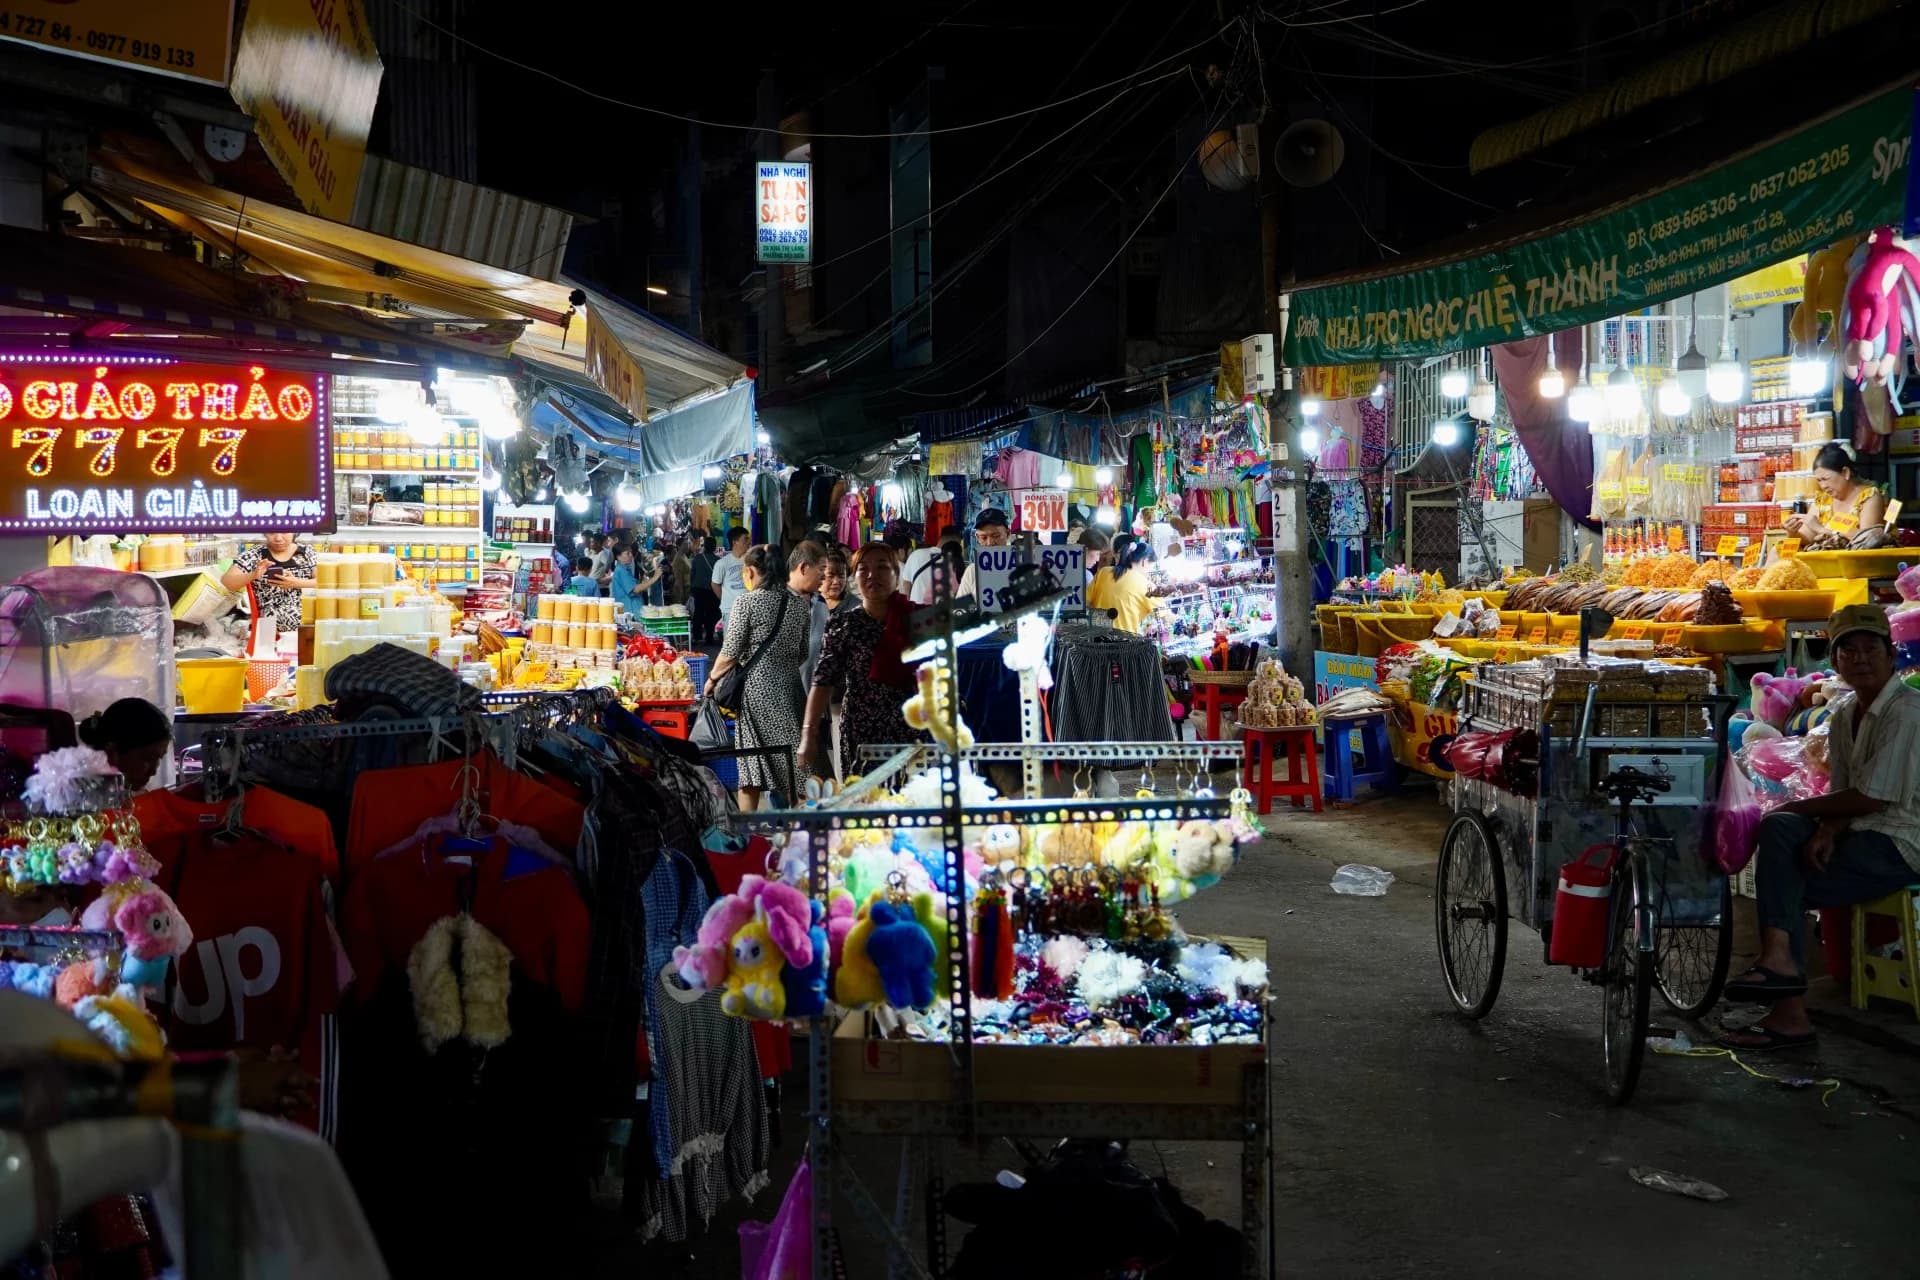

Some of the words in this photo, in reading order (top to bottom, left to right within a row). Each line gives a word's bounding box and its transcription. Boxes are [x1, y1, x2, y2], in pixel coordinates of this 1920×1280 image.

[16, 15, 46, 36] 727
[51, 22, 71, 42] 84
[87, 30, 126, 54] 0977
[132, 39, 161, 61] 919
[167, 47, 194, 67] 133
[1649, 215, 1681, 242] 0839
[1683, 203, 1708, 230] 666
[1709, 192, 1737, 219] 306
[1750, 171, 1785, 203] 0637
[1788, 159, 1817, 188] 062
[1819, 144, 1850, 175] 205
[1325, 305, 1361, 349] NHÀ
[1364, 308, 1400, 353] TRỌ
[1404, 296, 1463, 347] NGỌC
[1525, 255, 1618, 318] THÀNH
[166, 366, 312, 420] THẢO
[26, 489, 133, 518] LOAN
[145, 480, 238, 518] GIÀU
[1024, 501, 1065, 530] 39K
